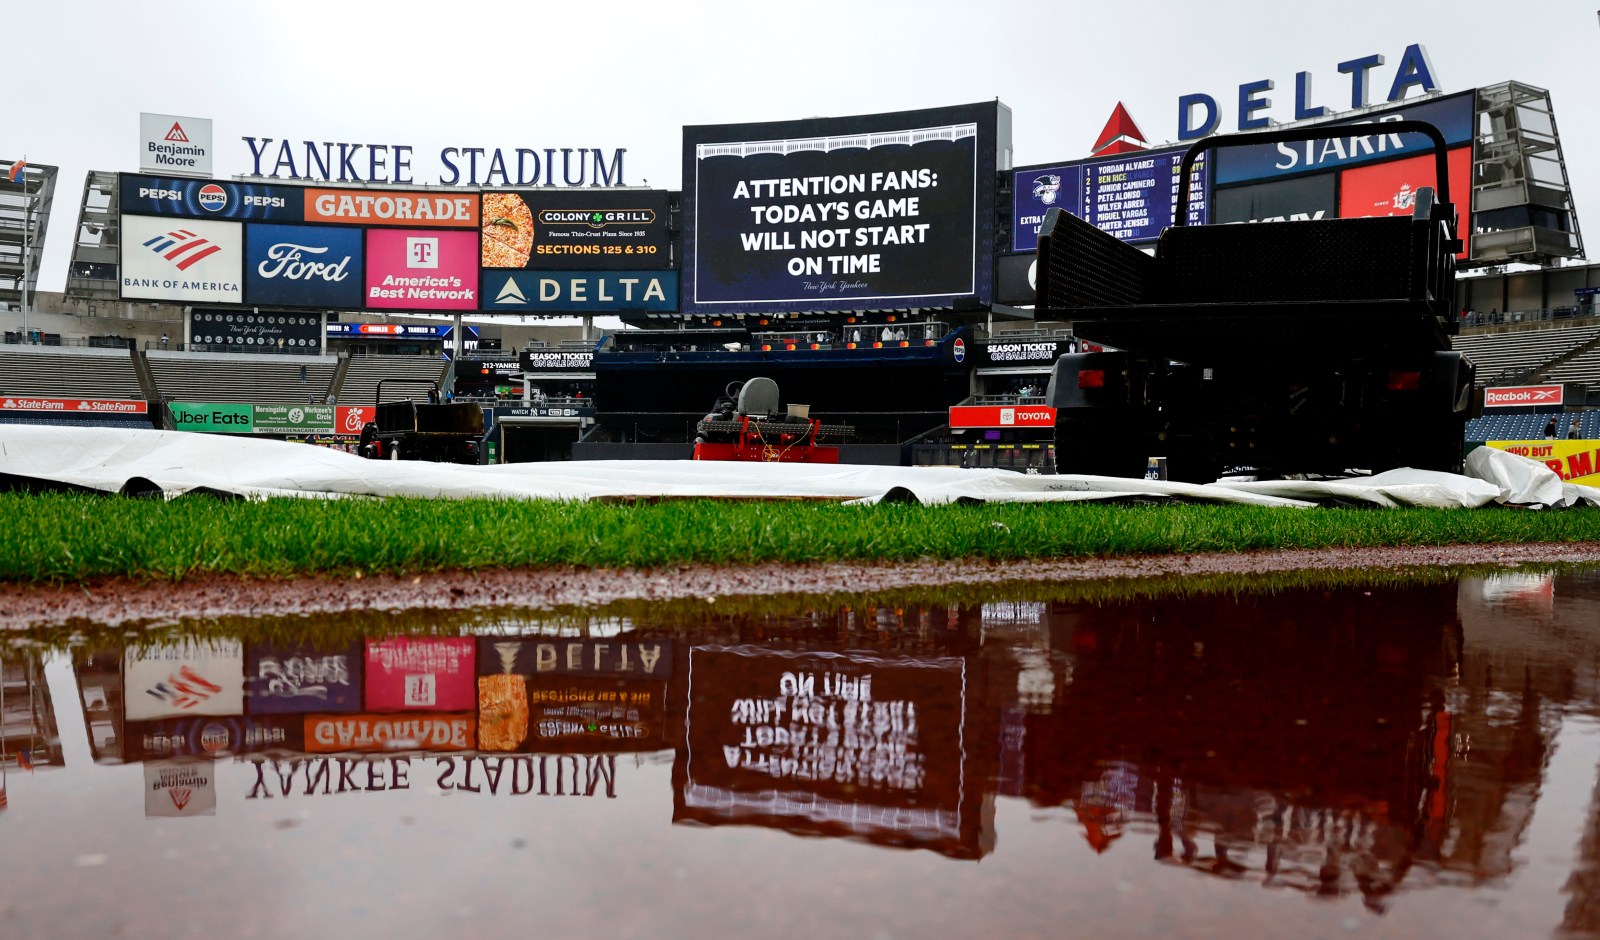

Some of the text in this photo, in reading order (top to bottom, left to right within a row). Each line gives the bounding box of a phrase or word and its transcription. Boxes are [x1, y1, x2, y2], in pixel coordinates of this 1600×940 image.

[1178, 43, 1442, 140] DELTA
[148, 142, 205, 157] Benjamin
[155, 153, 196, 167] Moore
[242, 136, 627, 187] YANKEE STADIUM
[1086, 168, 1091, 176] 1
[1098, 164, 1125, 175] YORDAN
[1125, 159, 1155, 172] ALVAREZ
[1172, 155, 1181, 165] 77
[733, 168, 938, 199] ATTENTION FANS:
[1098, 174, 1111, 184] BEN
[1112, 173, 1127, 182] RICE
[1098, 183, 1121, 194] JUNIOR
[1122, 179, 1155, 191] CAMINERO
[1191, 172, 1199, 182] TB
[139, 187, 182, 201] PEPSI
[200, 193, 226, 203] PEPSI
[1085, 196, 1091, 204] 4
[1098, 193, 1114, 203] PETE
[1115, 190, 1141, 201] ALONSO
[1190, 182, 1203, 191] BAL
[244, 195, 285, 208] PEPSI
[315, 194, 471, 221] GATORADE
[1085, 205, 1090, 213] 5
[1098, 201, 1122, 212] WILYER
[1123, 199, 1145, 210] ABREU
[1190, 192, 1203, 201] BOS
[545, 212, 650, 221] COLONY GRILL
[751, 197, 919, 224] TODAY'S GAME
[1097, 211, 1120, 222] MIGUEL
[1122, 208, 1147, 219] VARGAS
[1190, 201, 1204, 211] CWS
[1020, 215, 1042, 225] EXTRA
[1098, 220, 1122, 230] CARTER
[1123, 217, 1149, 228] JENSEN
[1189, 211, 1199, 221] KC
[741, 224, 930, 251] WILL NOT START
[1115, 229, 1132, 238] NETO
[414, 242, 431, 263] T
[536, 245, 657, 254] SECTIONS 125 & 310
[258, 242, 351, 282] Ford
[787, 254, 881, 276] ON TIME
[124, 277, 239, 292] BANK OF AMERICA
[382, 275, 462, 288] America's
[803, 280, 868, 293] New York Yankees
[369, 287, 475, 300] Best Network
[539, 278, 666, 302] DELTA
[464, 340, 479, 350] NYY
[987, 343, 1057, 353] SEASON TICKETS
[529, 353, 561, 361] SEASON
[991, 351, 1053, 360] ON SALE NOW!
[1487, 391, 1531, 402] Reebok
[213, 411, 249, 424] Eats
[255, 406, 288, 415] Morningside
[1017, 412, 1050, 420] TOYOTA
[1532, 446, 1553, 456] BUT
